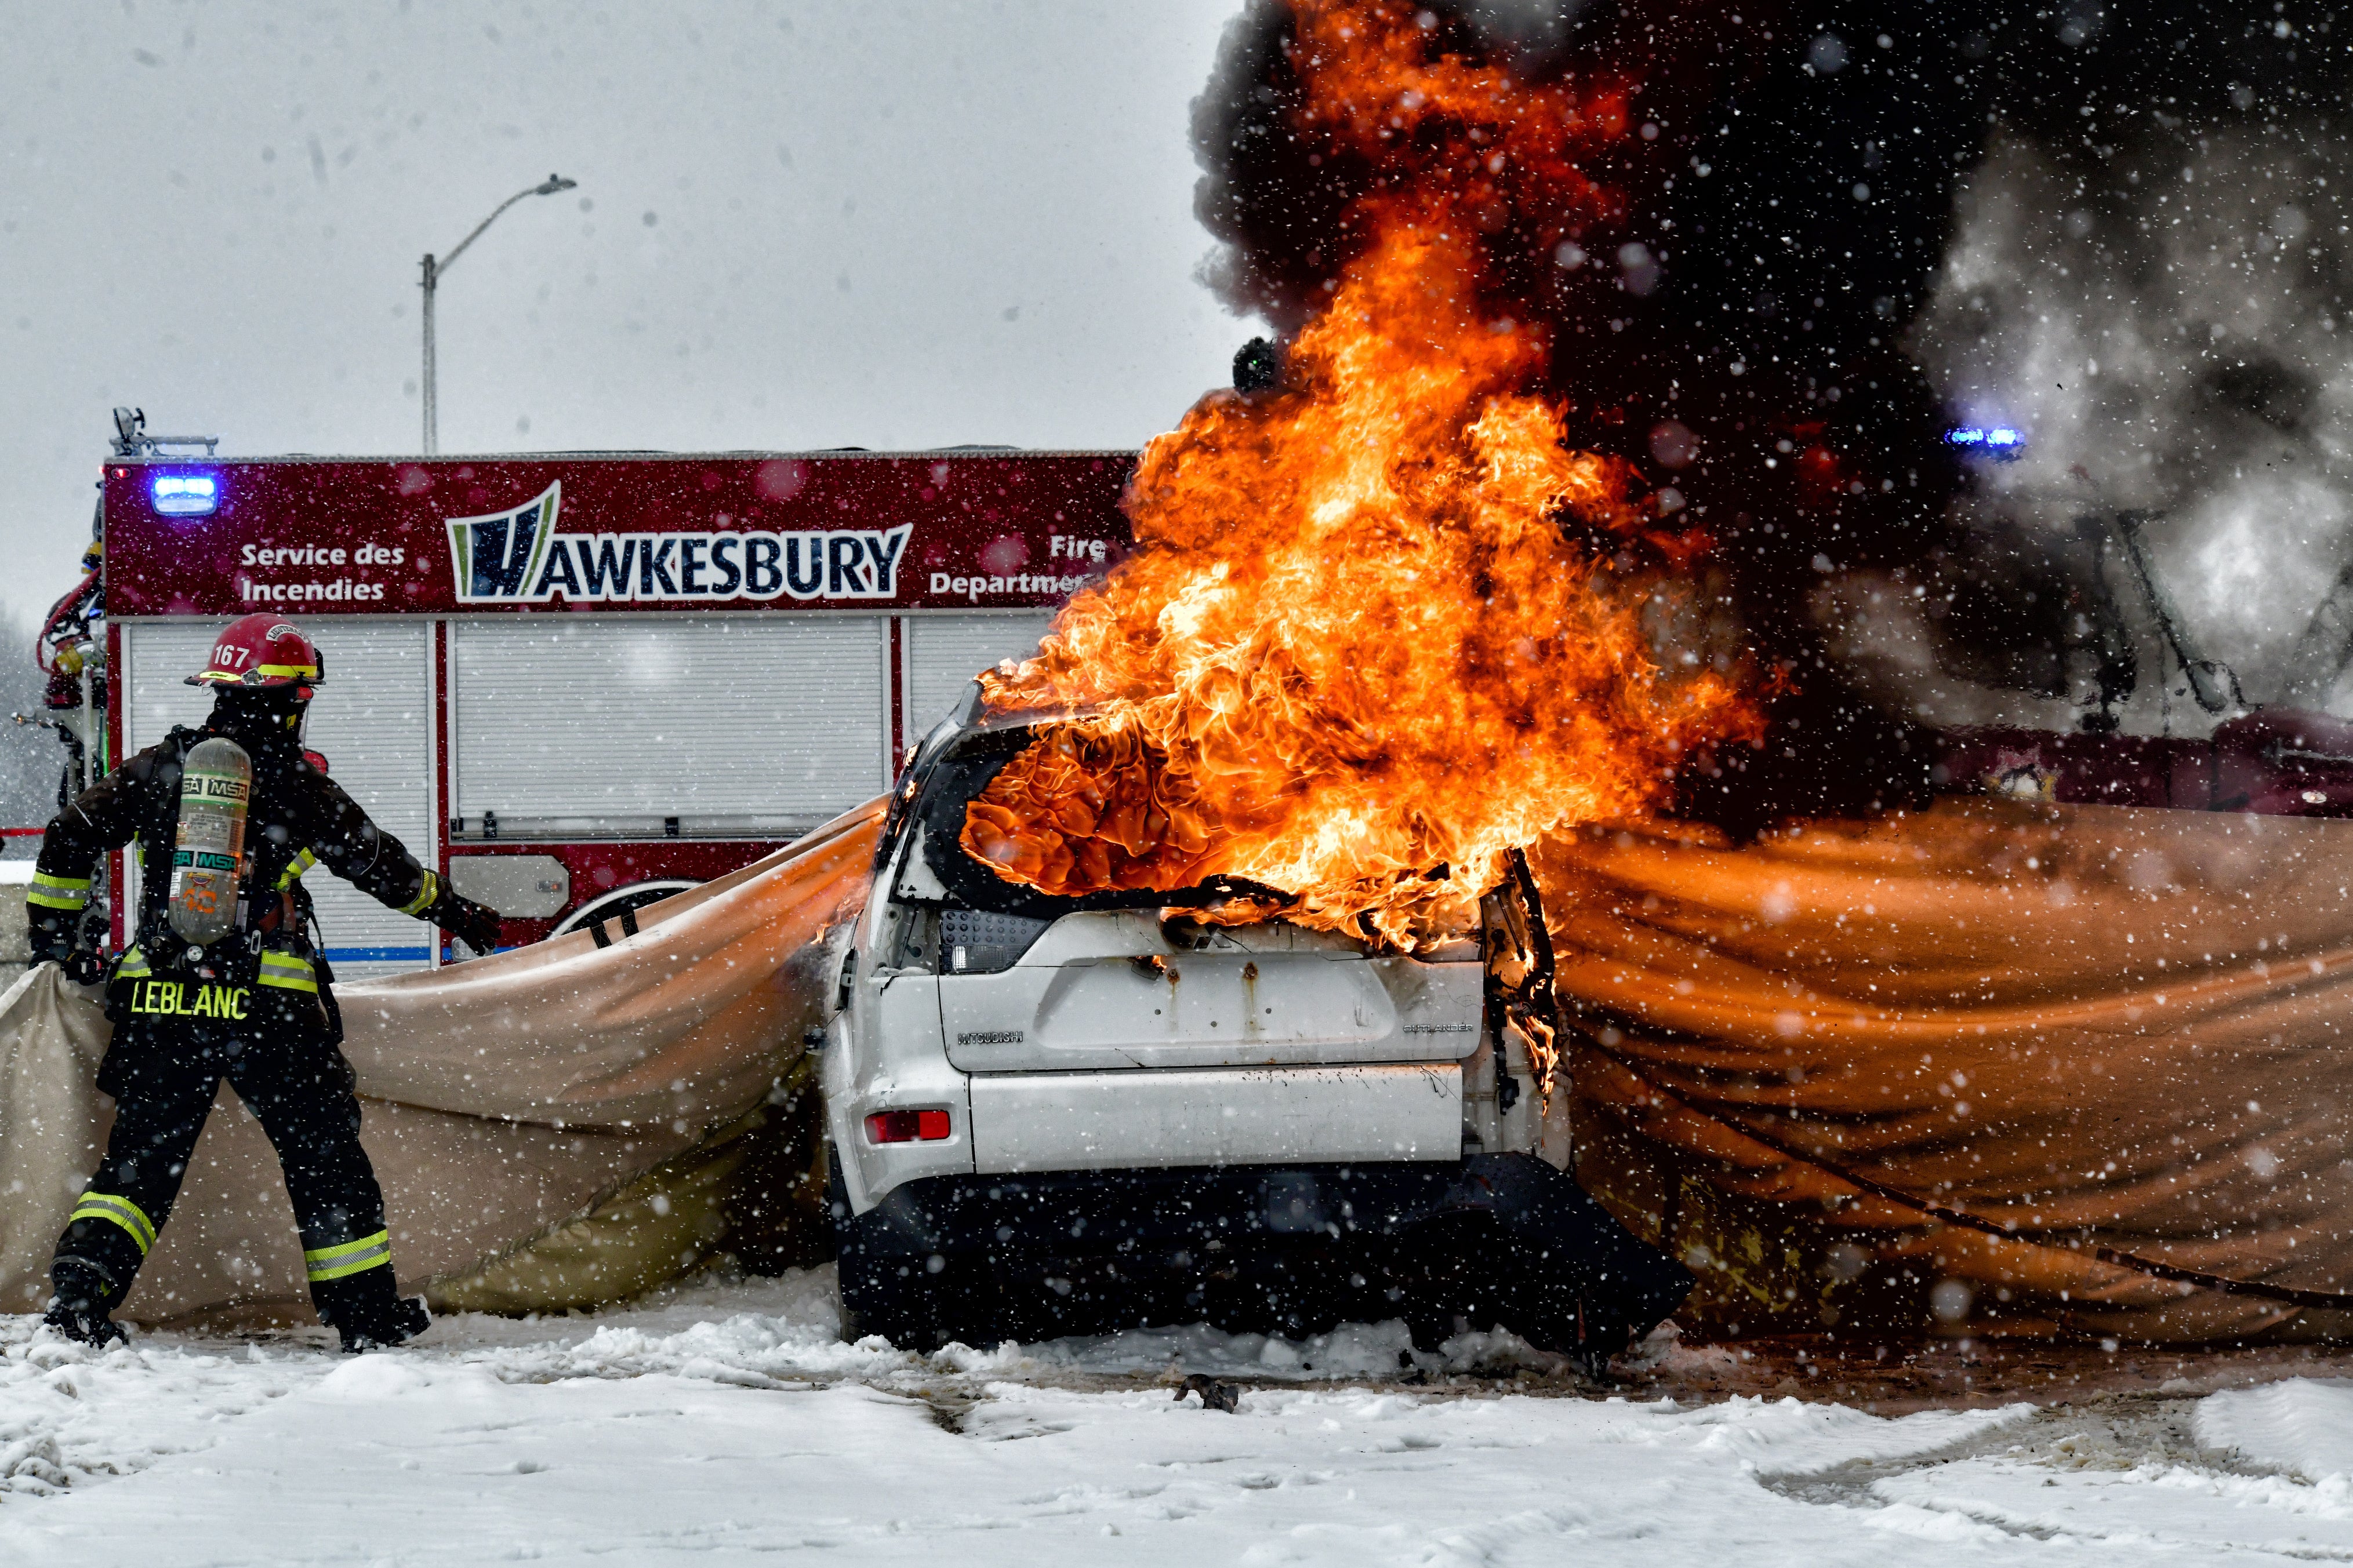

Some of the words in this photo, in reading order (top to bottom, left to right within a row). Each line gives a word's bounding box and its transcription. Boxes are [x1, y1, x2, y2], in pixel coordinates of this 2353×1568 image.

[241, 543, 347, 566] Service
[354, 543, 405, 565] des
[1051, 535, 1106, 562] Fire
[242, 579, 384, 601] Incendies
[930, 572, 1095, 601] Departme
[214, 644, 249, 668] 167
[183, 780, 199, 792] SA
[210, 781, 246, 799] MSA
[173, 852, 191, 865] SA
[198, 853, 236, 870] MSA
[131, 981, 250, 1020] LEBLANC
[957, 1031, 1023, 1045] MITSUBISHI
[1403, 1024, 1474, 1033] OUTLANDER
